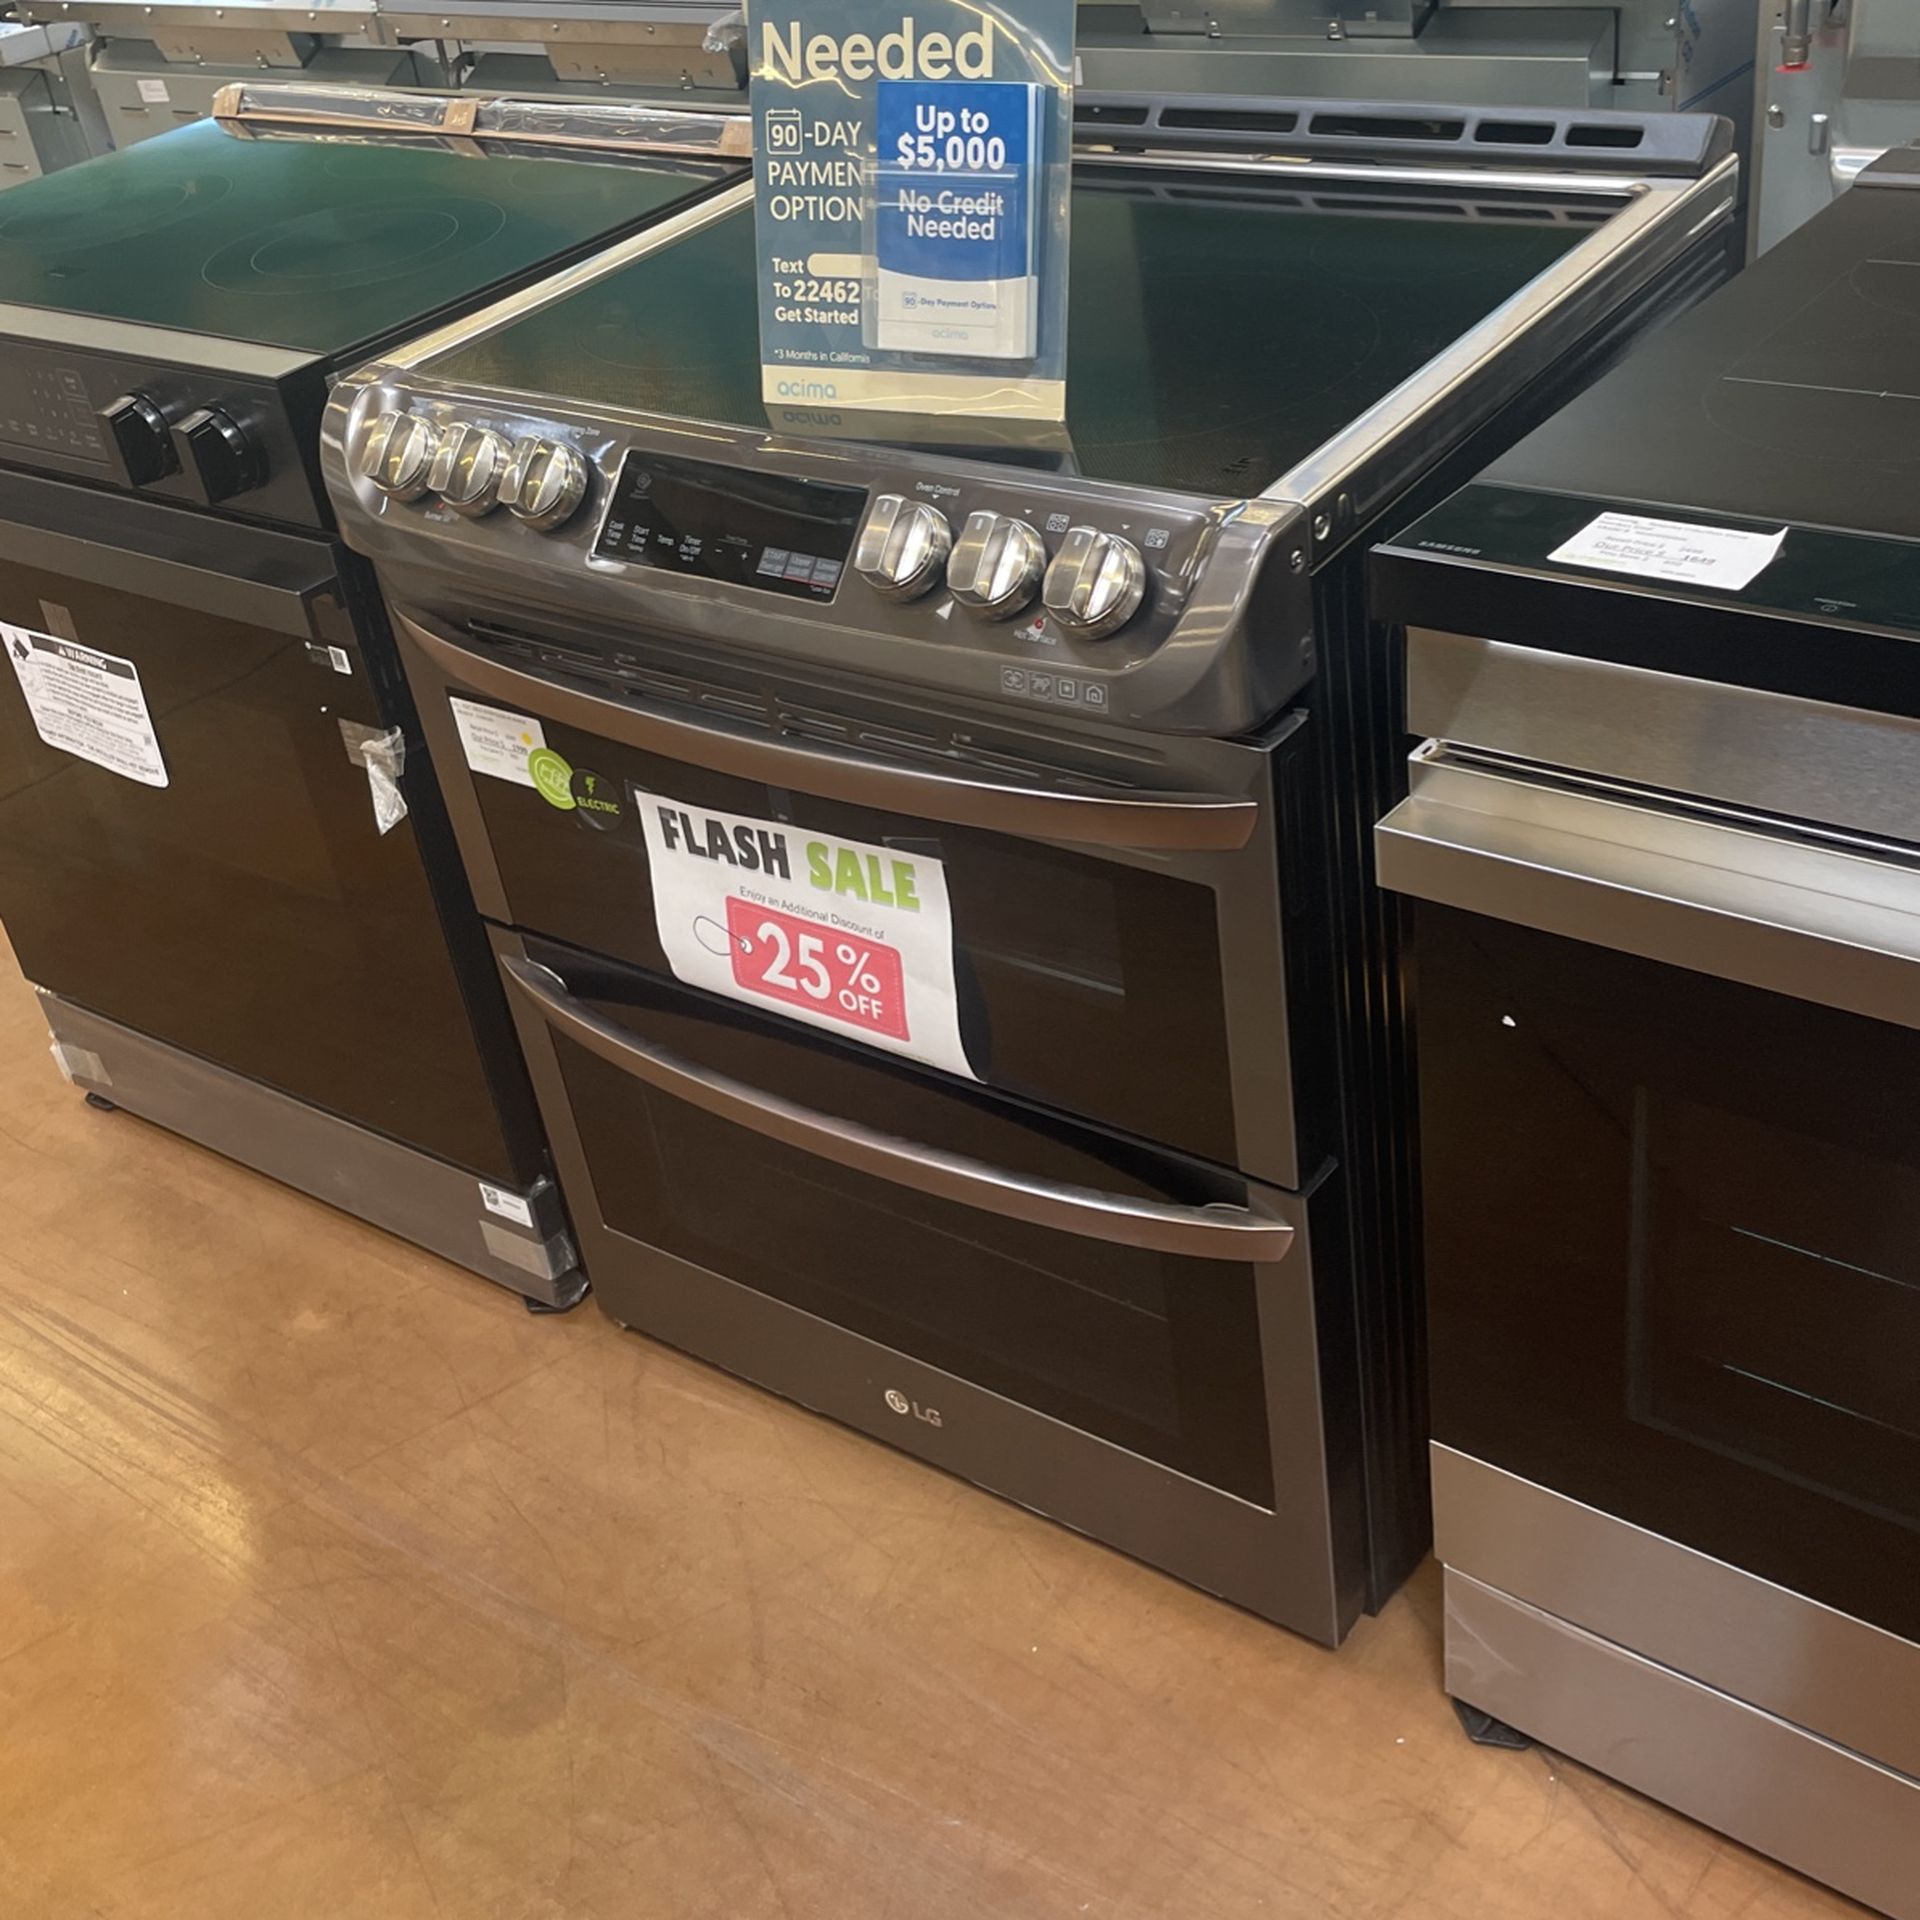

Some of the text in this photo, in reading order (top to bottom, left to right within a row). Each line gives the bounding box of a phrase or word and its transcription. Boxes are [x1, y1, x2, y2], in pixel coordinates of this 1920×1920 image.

[762, 17, 994, 81] Needed
[916, 105, 989, 139] Up to
[897, 132, 1005, 173] $5,000
[900, 189, 1004, 216] No Credit
[908, 214, 995, 240] Needed
[772, 257, 804, 274] Text
[773, 280, 860, 304] To 22462
[775, 306, 859, 325] Get Started
[931, 328, 969, 340] acima
[786, 349, 818, 361] Months
[820, 352, 829, 361] in
[830, 352, 871, 364] California
[777, 378, 837, 399] acima
[577, 796, 620, 815] ELECTRIC
[657, 805, 921, 914] FLASH SALE
[739, 885, 885, 940] Enjoy an Additional Discount of
[838, 989, 883, 1020] OFF
[912, 1401, 943, 1428] LG
